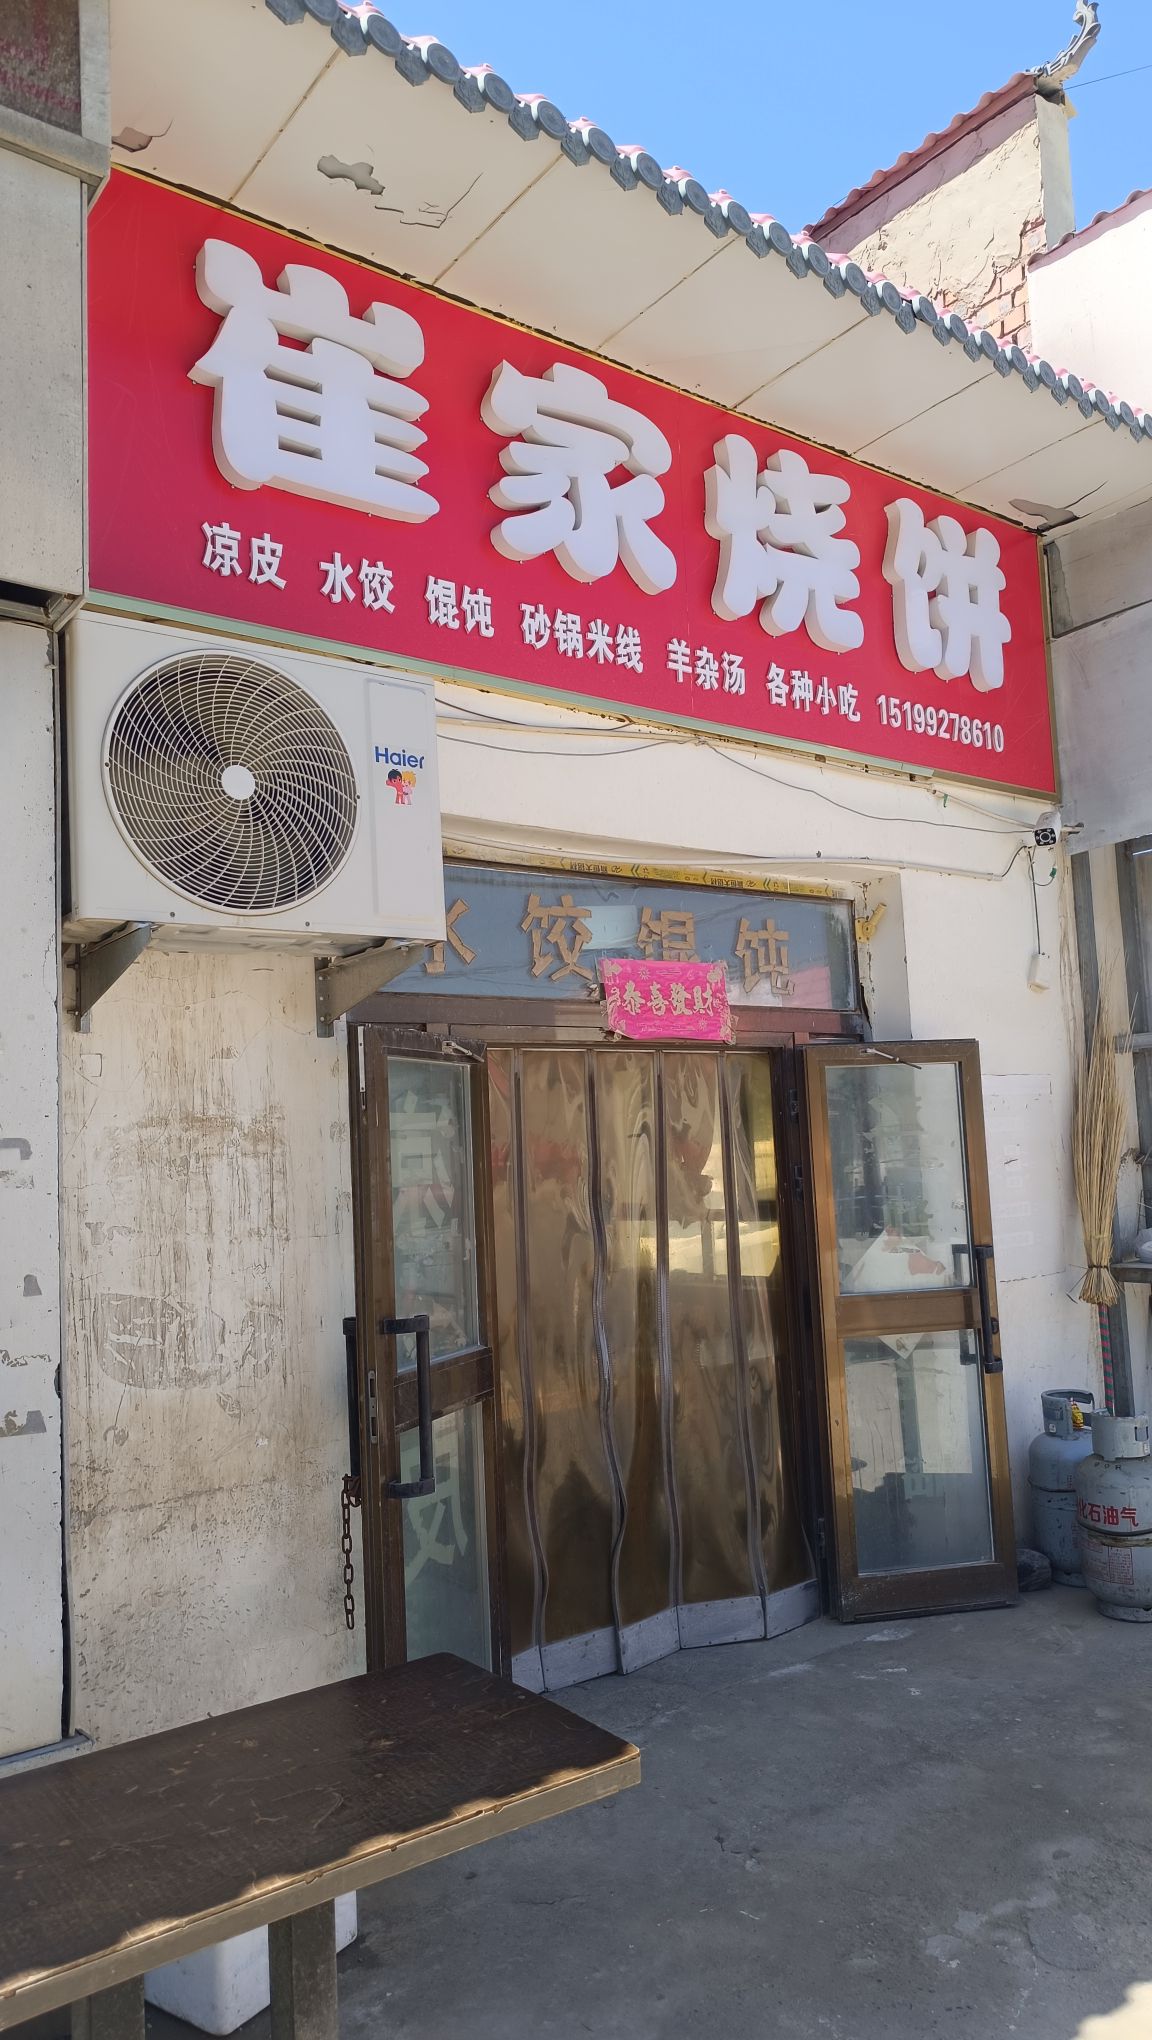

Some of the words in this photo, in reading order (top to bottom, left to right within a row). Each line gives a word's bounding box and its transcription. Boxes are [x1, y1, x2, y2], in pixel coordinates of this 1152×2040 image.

[187, 238, 1011, 693] 崔家烧饼
[202, 521, 287, 589] 凉皮
[319, 551, 396, 614] 水饺
[424, 575, 495, 638] 馄饨
[519, 602, 644, 674] 砂锅米线
[666, 637, 746, 696] 羊杂汤
[765, 662, 861, 723] 各种小吃
[876, 694, 1005, 753] 15199278610
[374, 745, 425, 769] Haier
